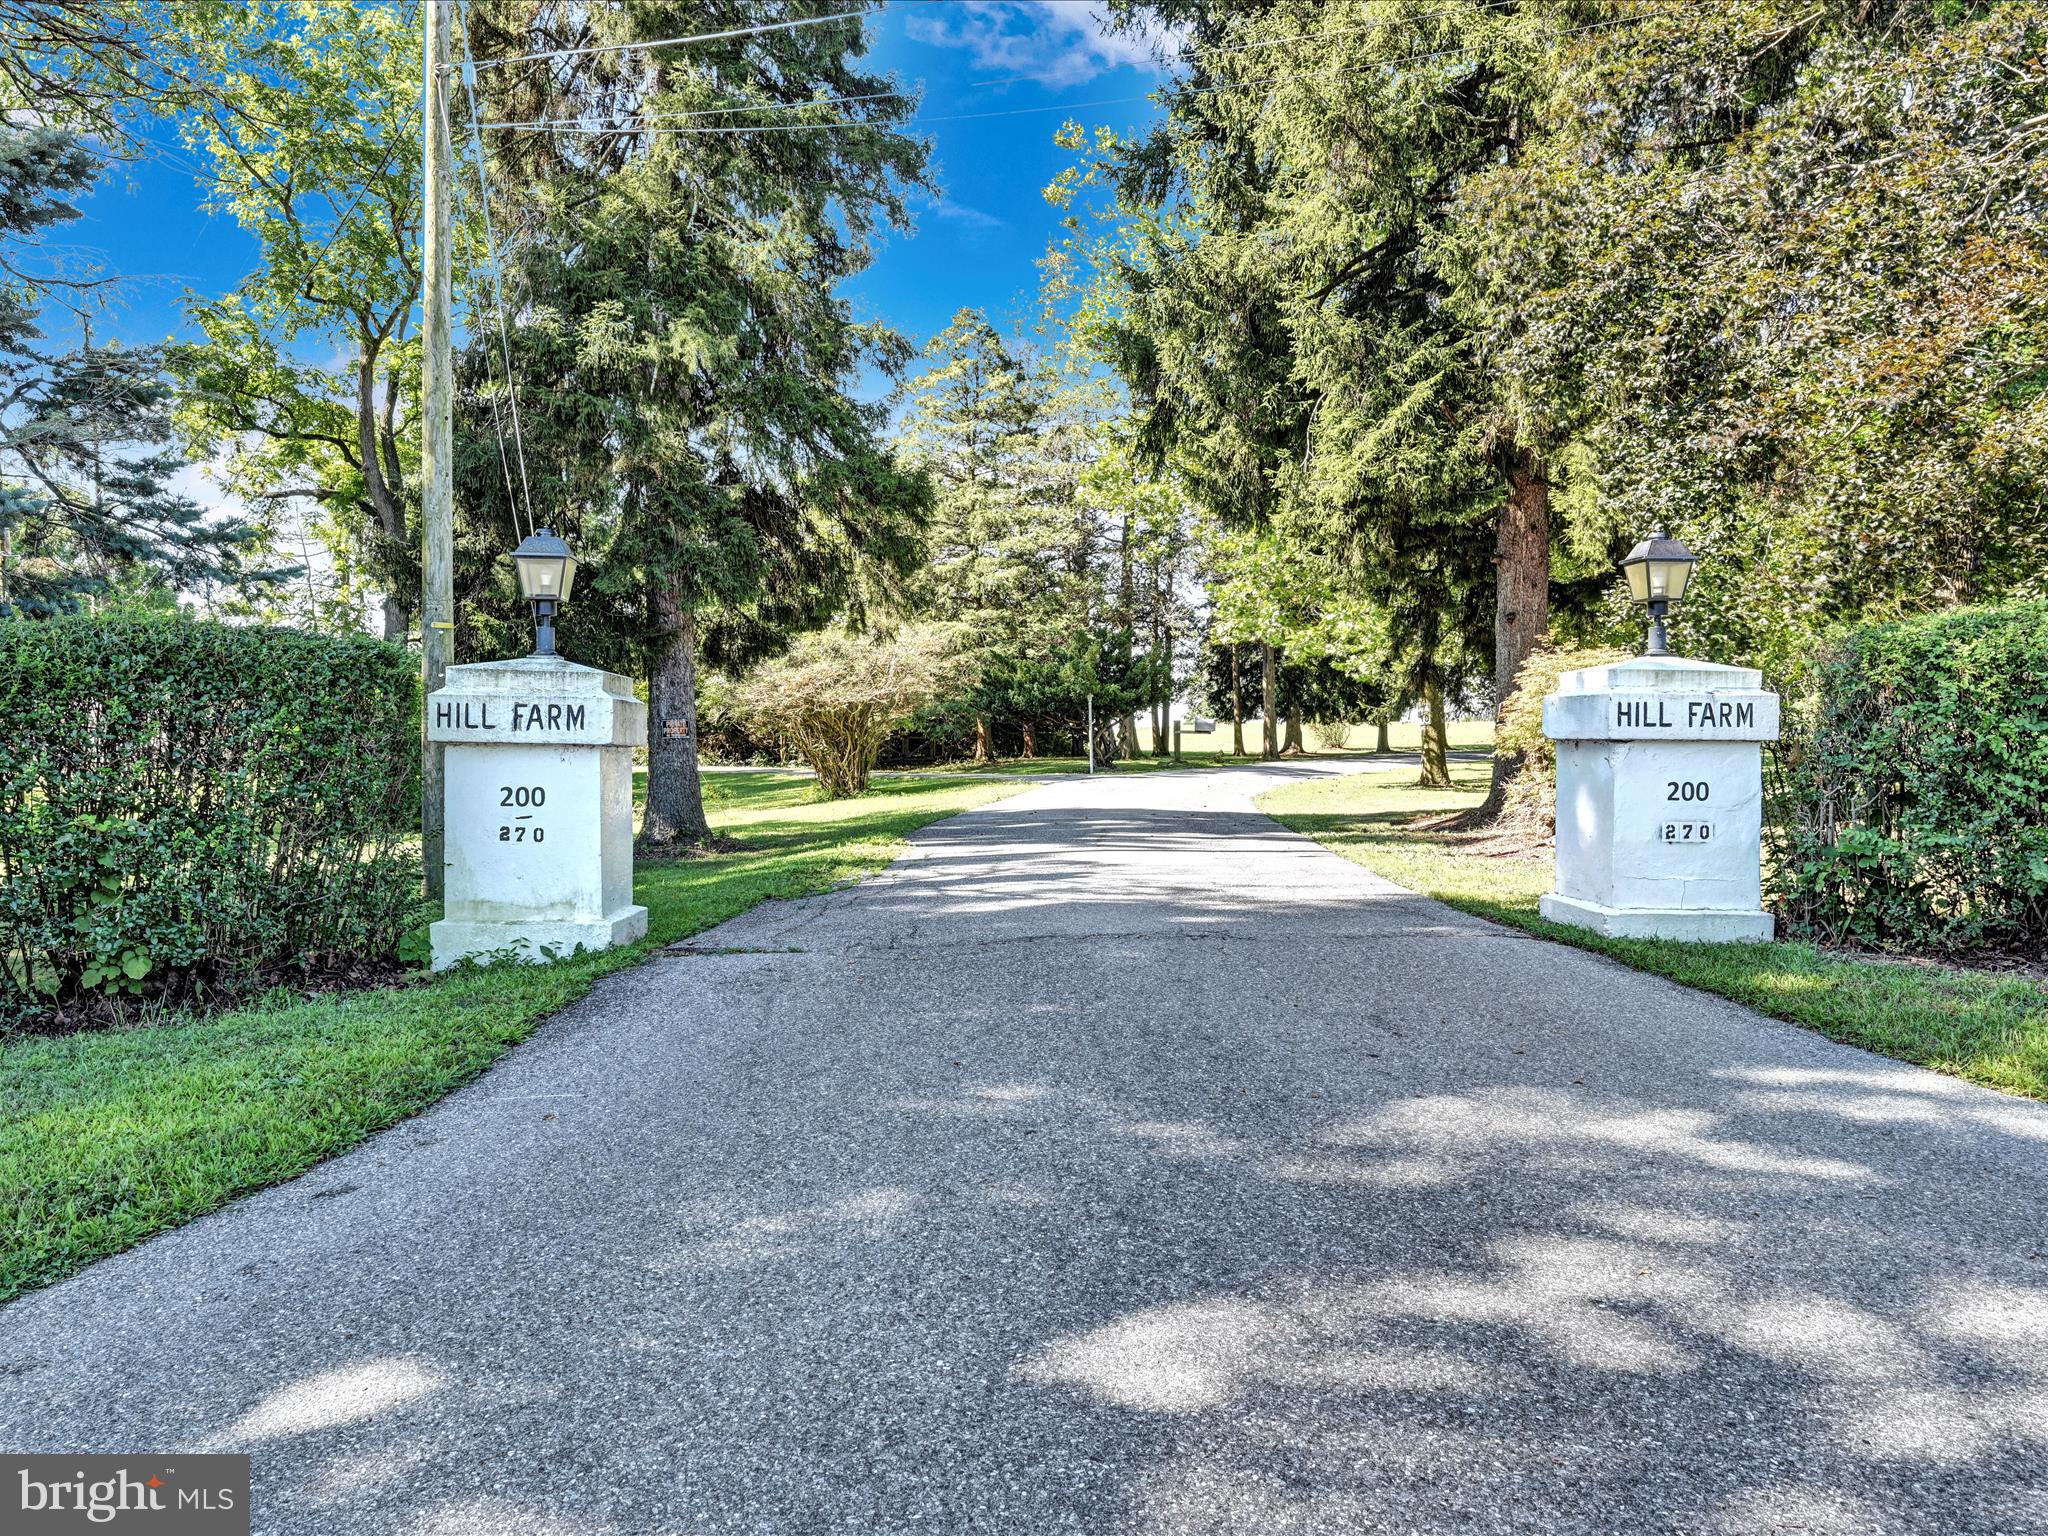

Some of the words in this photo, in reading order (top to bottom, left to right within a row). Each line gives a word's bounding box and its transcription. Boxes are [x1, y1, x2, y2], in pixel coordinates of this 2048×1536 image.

[436, 702, 496, 729] HILL
[512, 702, 585, 731] FARM
[1617, 701, 1672, 728] HILL
[1688, 702, 1754, 728] FARM
[500, 786, 546, 807] 200
[1667, 781, 1710, 802] 200
[499, 825, 545, 843] 270
[1665, 824, 1710, 840] 270
